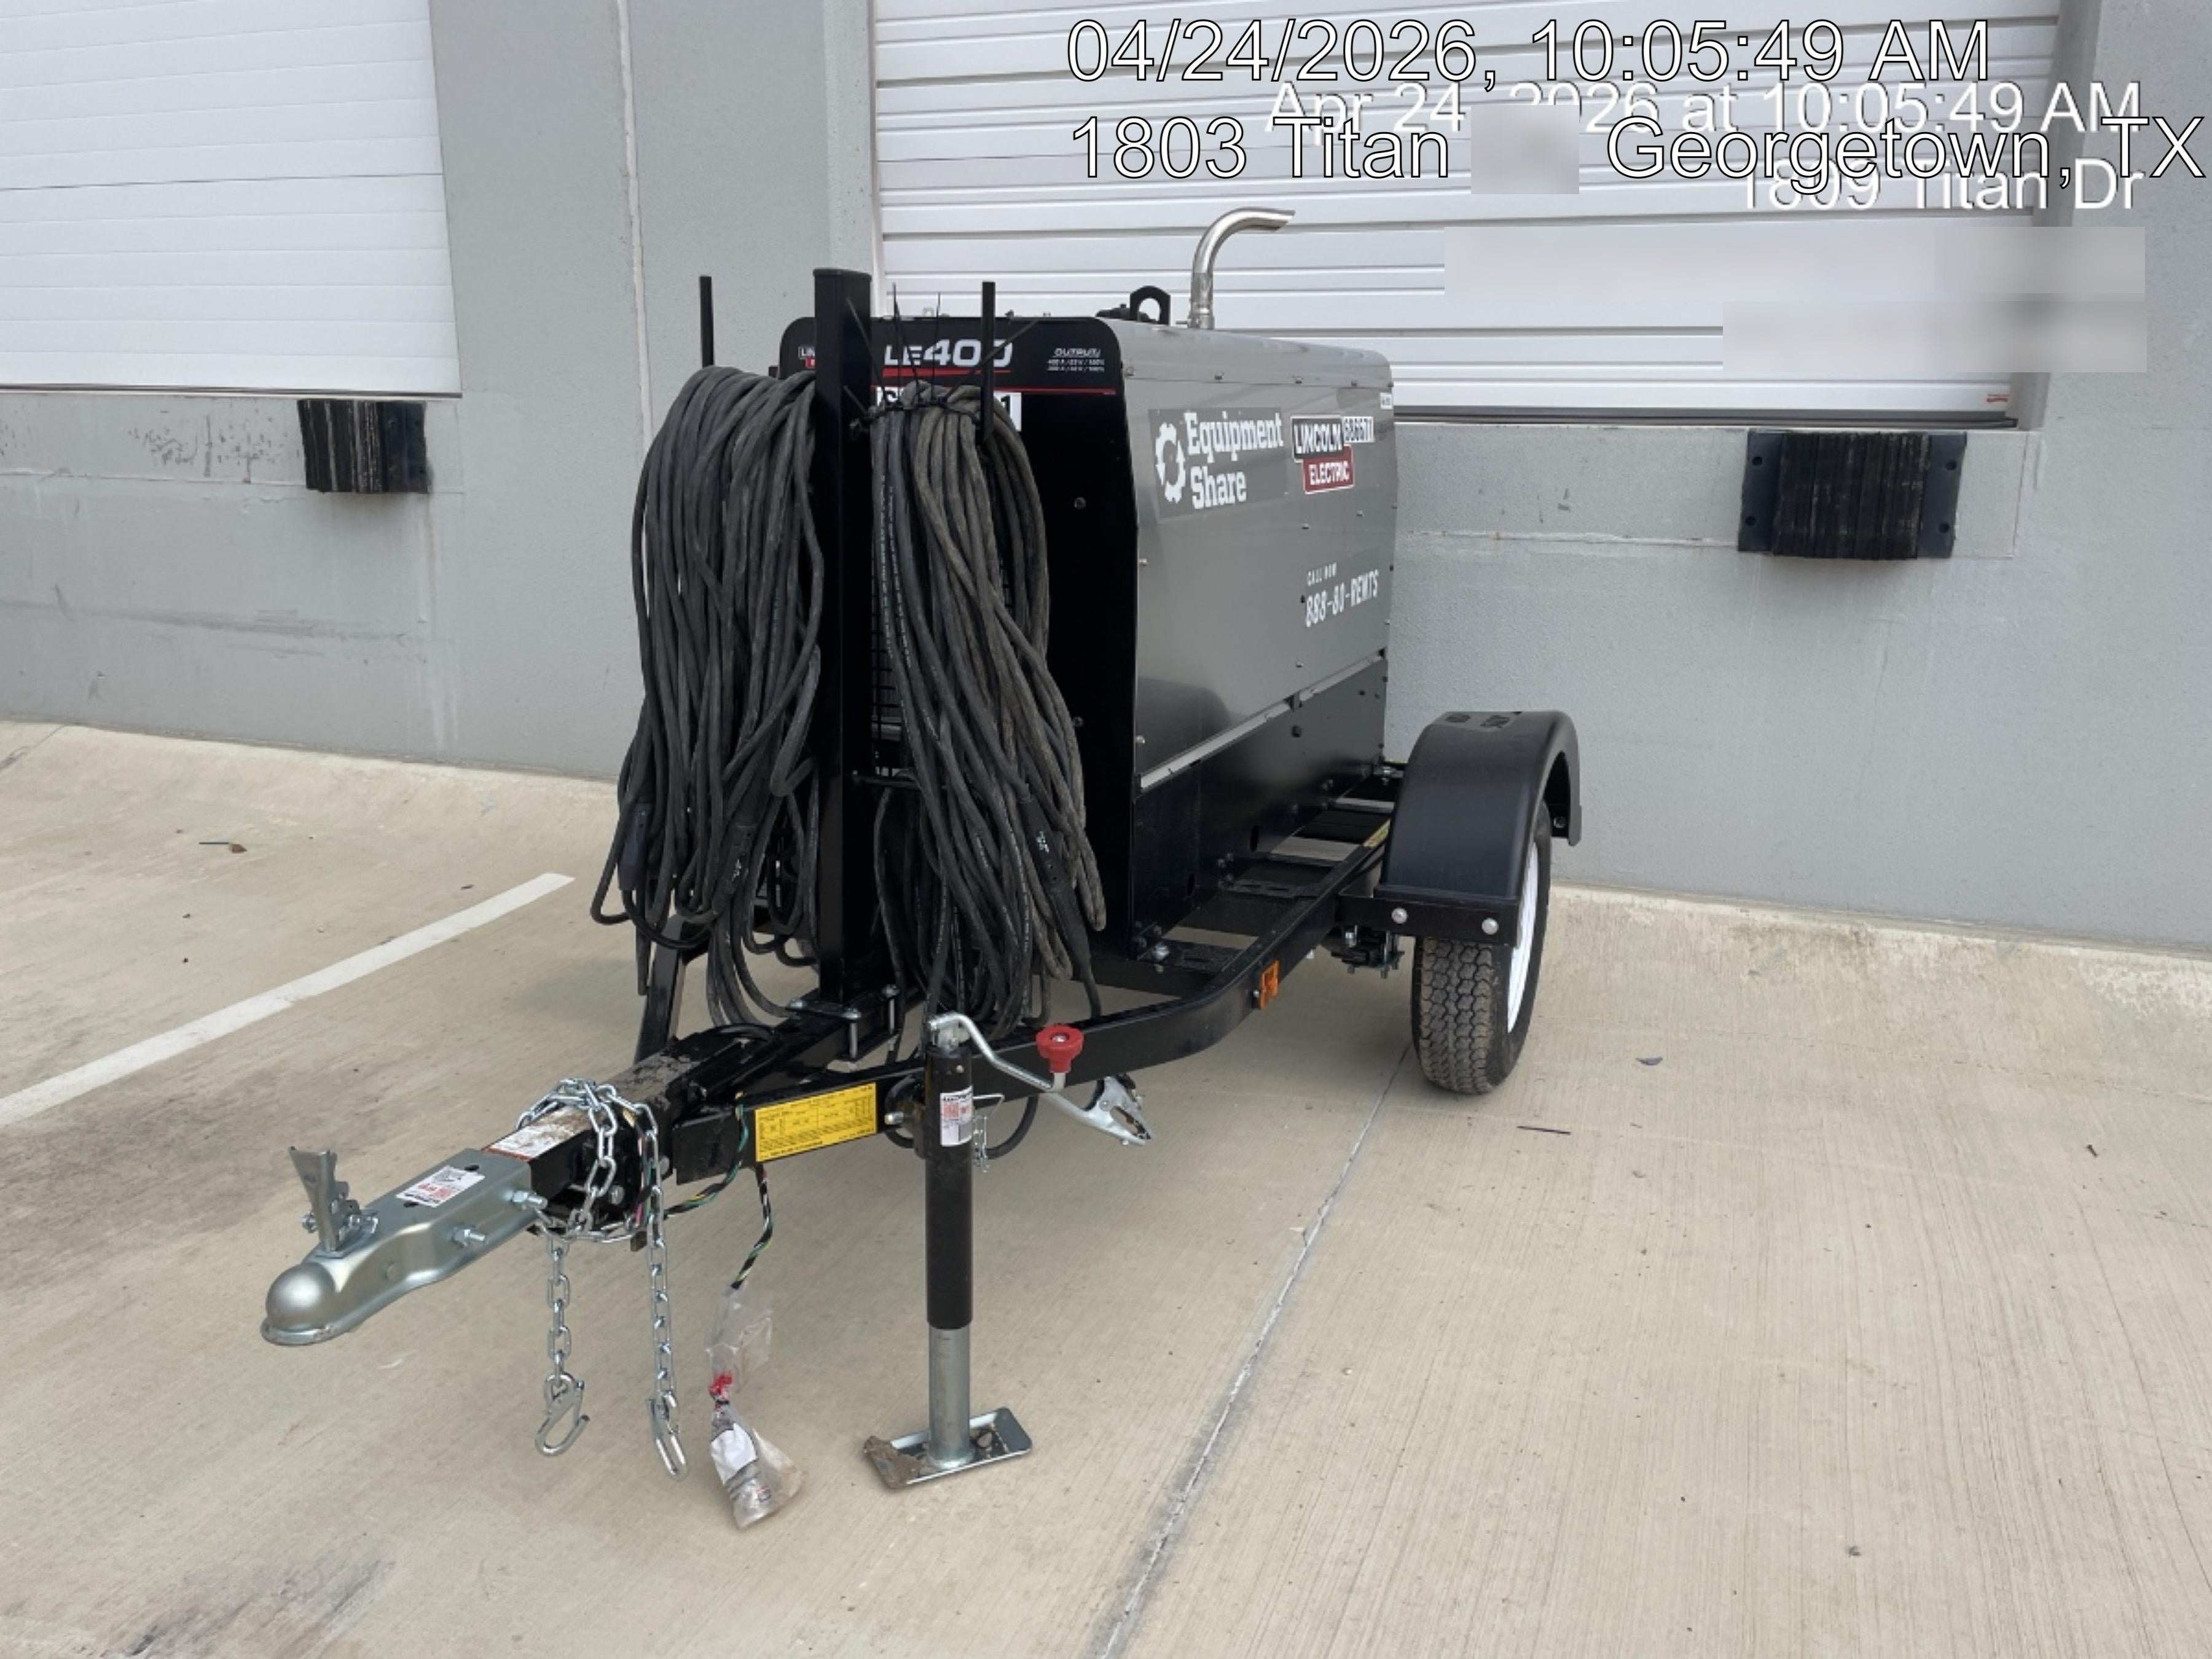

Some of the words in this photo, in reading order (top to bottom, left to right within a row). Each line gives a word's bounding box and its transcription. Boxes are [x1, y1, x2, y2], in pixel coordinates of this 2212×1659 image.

[1183, 411, 1285, 463] Equipment
[1294, 423, 1343, 454] LINCOLN
[1191, 466, 1247, 509] Share
[1309, 461, 1351, 485] ELECTRIC
